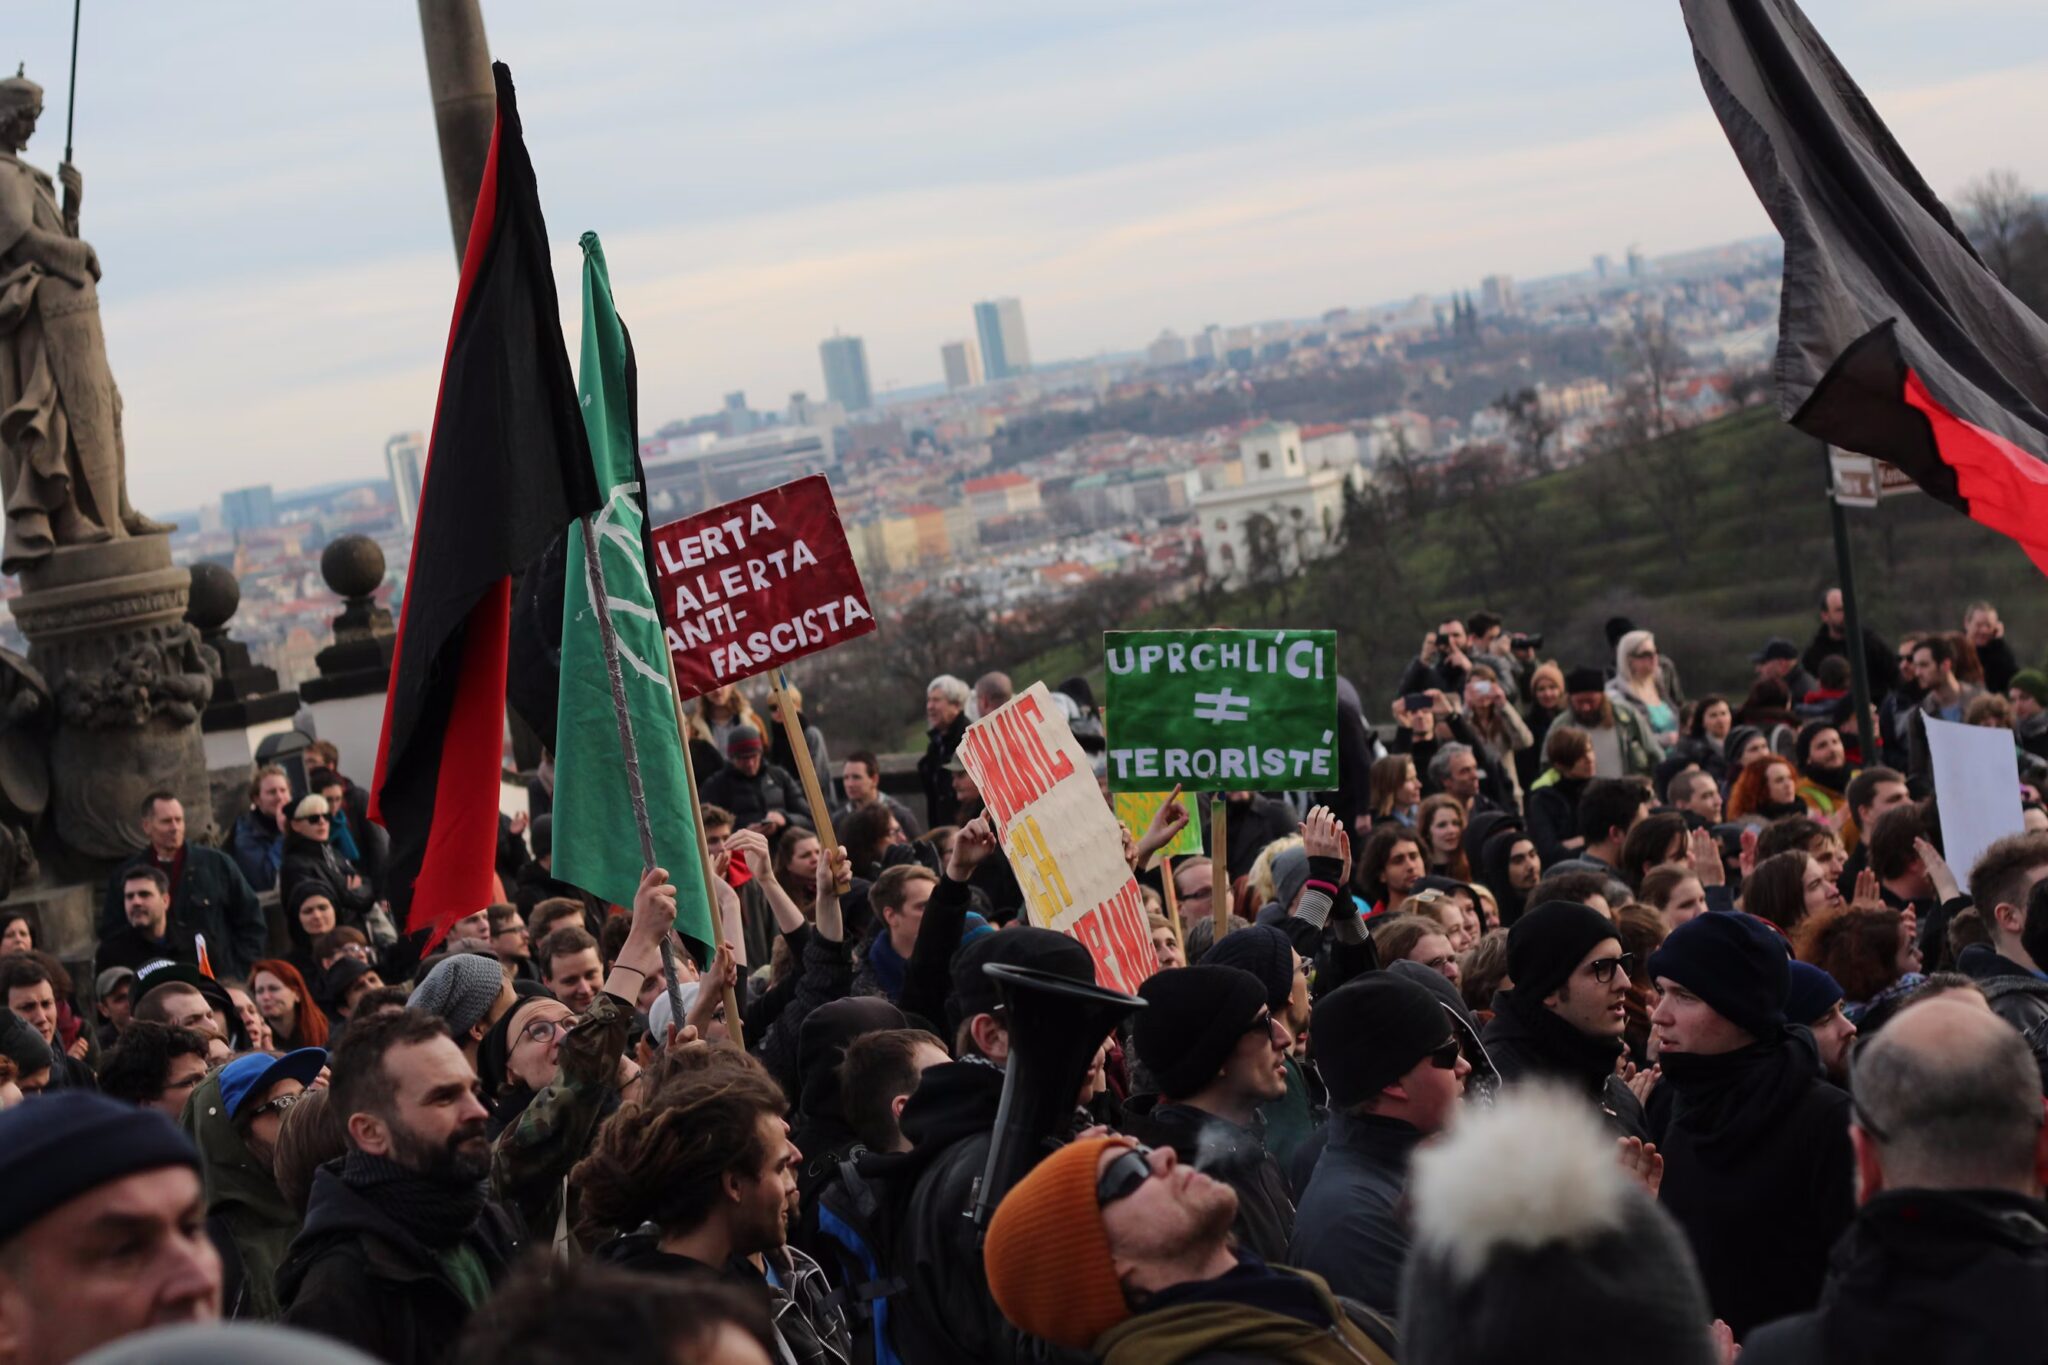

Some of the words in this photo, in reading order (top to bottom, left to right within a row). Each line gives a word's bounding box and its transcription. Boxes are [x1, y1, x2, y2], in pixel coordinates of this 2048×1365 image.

[655, 503, 777, 576] LERTA
[675, 539, 818, 619] ALERTA
[666, 603, 748, 653] ANTI-
[710, 595, 872, 679] FASCISTA
[1106, 630, 1325, 680] UPRCHLÍCI
[1109, 729, 1334, 779] TERORISTÉ
